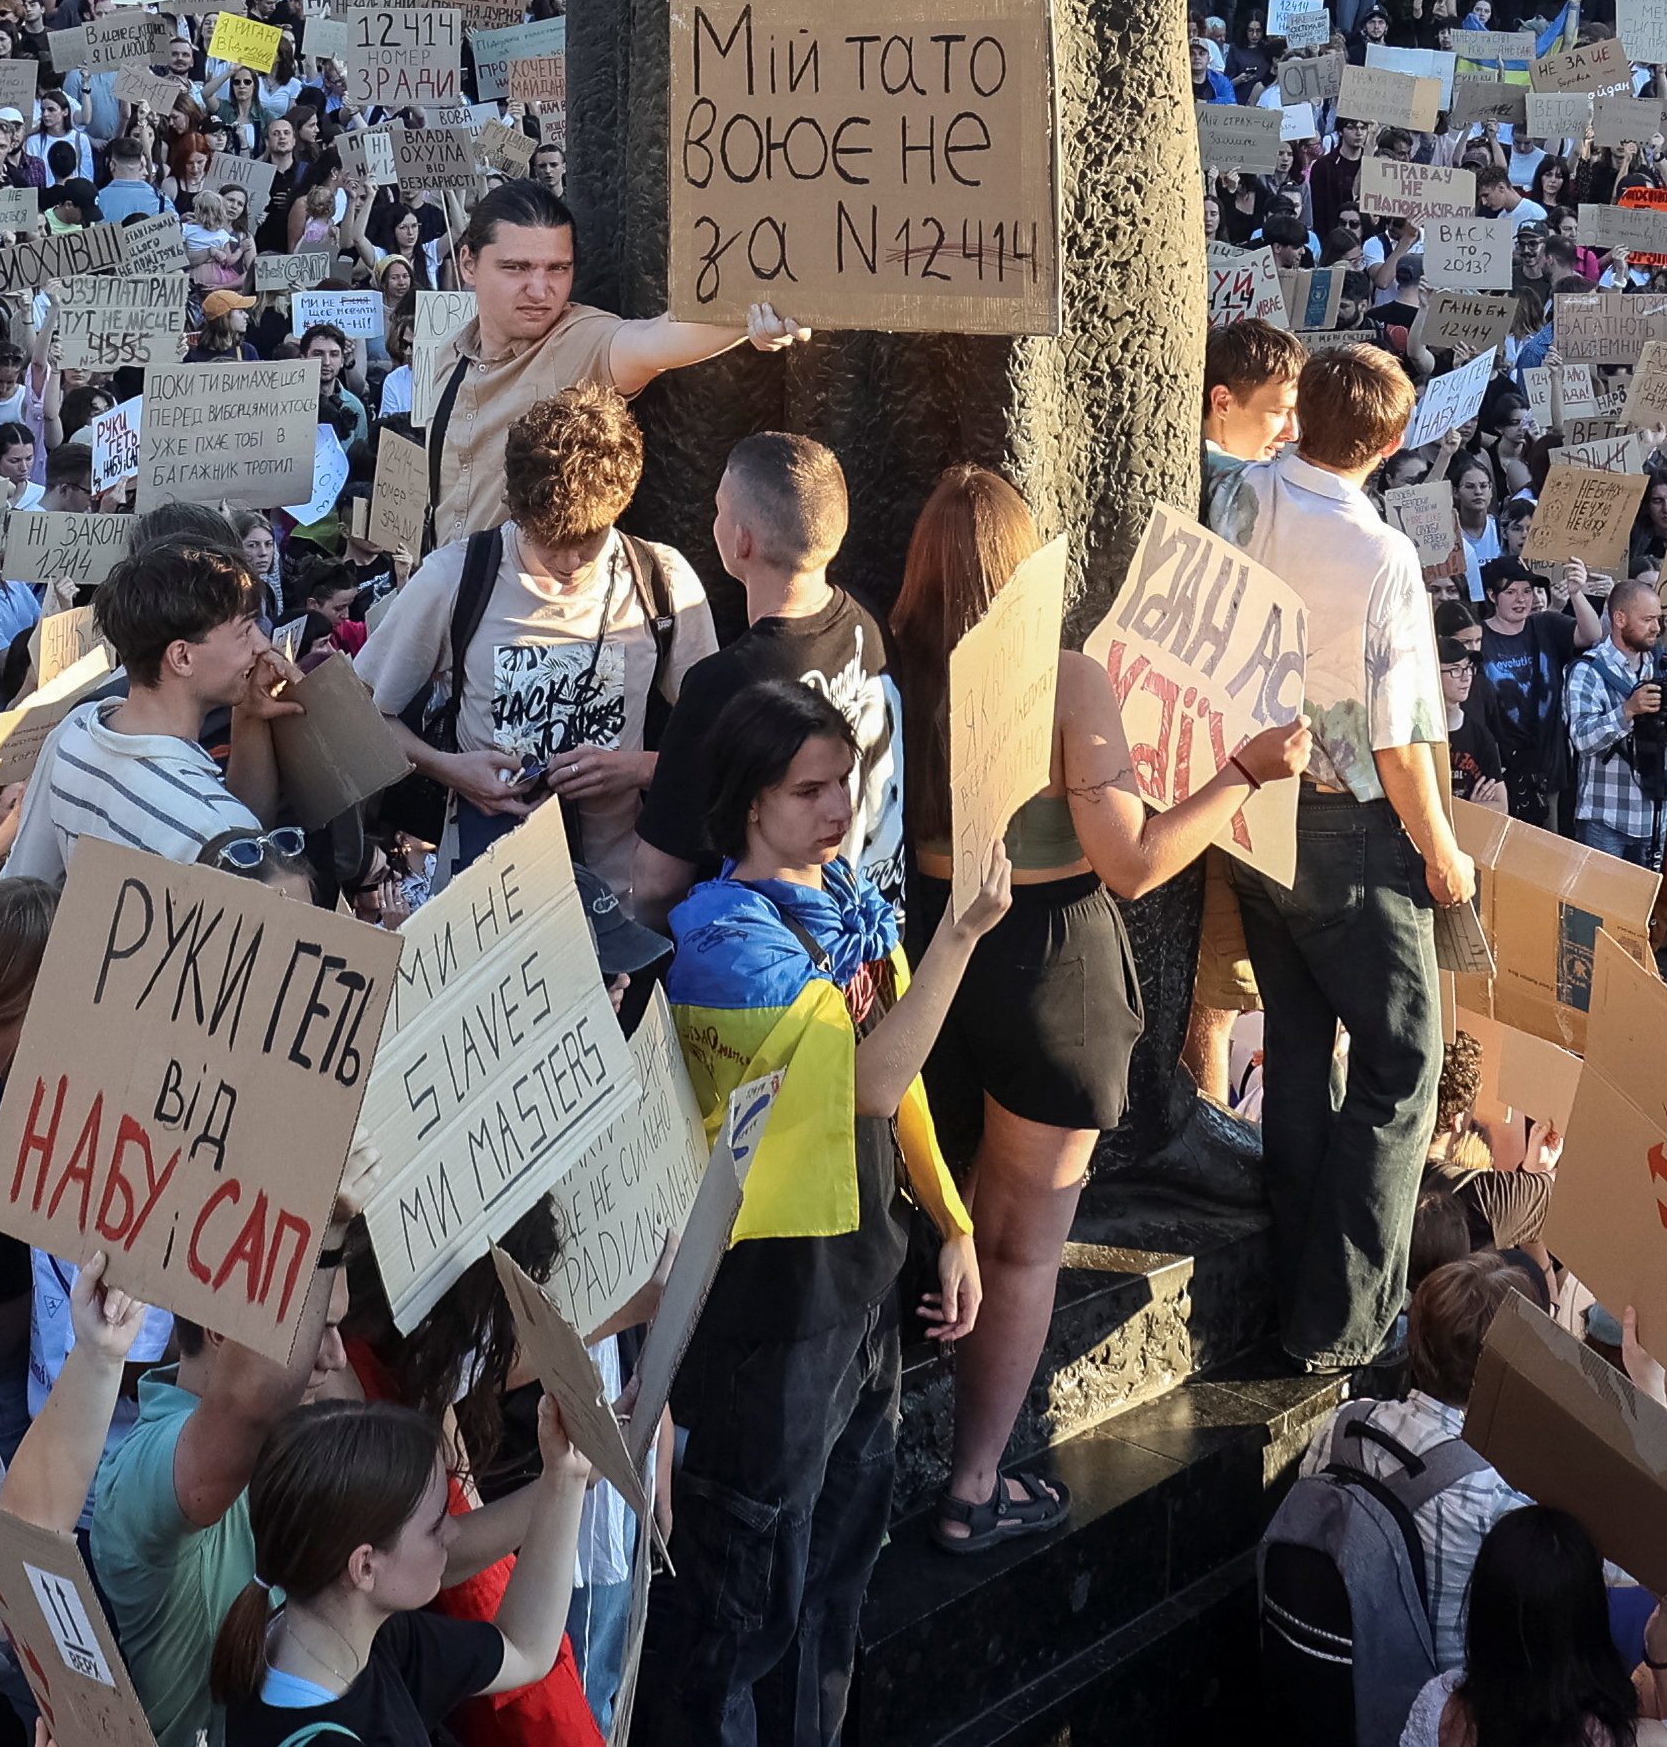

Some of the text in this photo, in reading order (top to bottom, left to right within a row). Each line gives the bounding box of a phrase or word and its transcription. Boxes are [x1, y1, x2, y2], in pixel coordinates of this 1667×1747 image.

[235, 21, 279, 44] РИГАЮ
[356, 13, 455, 48] 12414
[368, 50, 431, 67] НОМЕР
[694, 5, 1006, 97] Мій тато
[357, 66, 457, 103] ЗРАДИ
[403, 130, 455, 145] ВЛАДА
[683, 98, 991, 188] воює не
[399, 142, 467, 165] ОХУЇЛА
[1381, 161, 1454, 184] ПРАВДУ
[1401, 179, 1421, 197] НЕ
[694, 216, 798, 303] за
[1443, 256, 1491, 276] 2013?
[61, 276, 184, 307] УЗУРПАТОРАМ
[1438, 303, 1508, 318] ГАНЬБА
[1440, 324, 1492, 338] 12414
[148, 374, 195, 403] ДОКИ
[199, 374, 218, 392] ТИ
[95, 412, 128, 439] РУКИ
[148, 404, 204, 428] ПЕРЕД
[108, 428, 138, 450] ГЕТЬ
[152, 455, 293, 488] БАГАЖНИК ТРОТИЛ
[35, 548, 89, 580] 12414
[491, 680, 573, 730] JACK
[392, 864, 525, 1032] МИ НЕ
[92, 877, 376, 1088] РУКИ ГЕТЬ
[402, 951, 552, 1142] SLAVES
[153, 1057, 238, 1172] від
[399, 1015, 608, 1273] МИ MASTERS
[9, 1074, 311, 1324] НАБУ і САП
